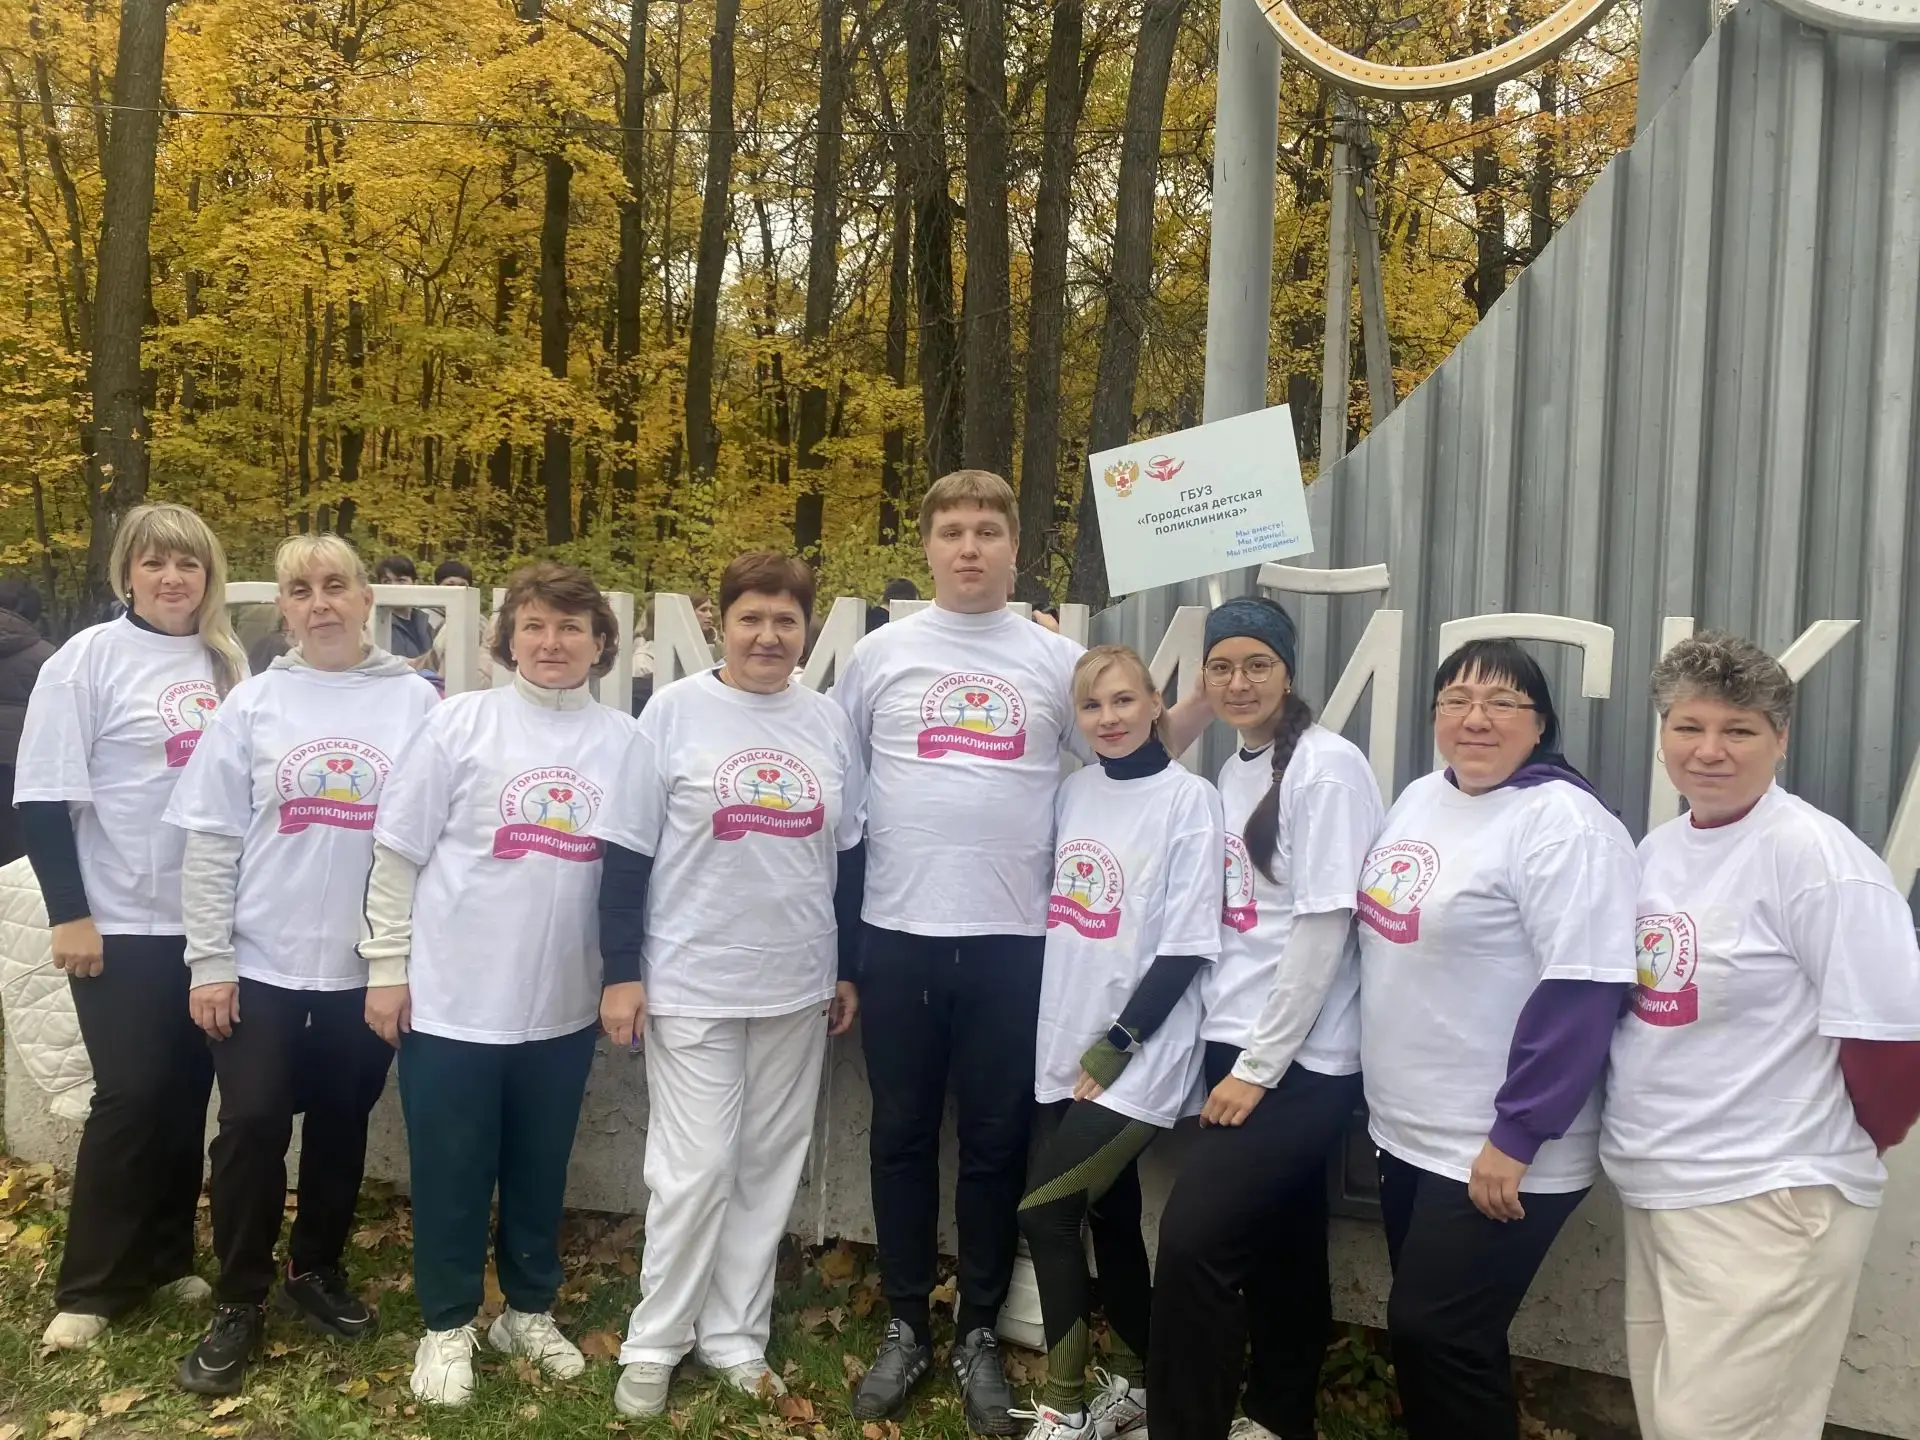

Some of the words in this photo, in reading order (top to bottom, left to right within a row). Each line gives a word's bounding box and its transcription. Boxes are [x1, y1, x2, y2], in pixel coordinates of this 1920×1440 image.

[1180, 485, 1213, 502] ГБУЗ
[1137, 501, 1208, 526] «Городская
[1212, 488, 1263, 510] детская
[1155, 507, 1248, 535] поликлиника»
[1235, 529, 1250, 538] Мы
[1251, 520, 1284, 534] вместе!
[1226, 549, 1241, 557] Мы
[1242, 536, 1299, 554] непобедимы!
[1238, 538, 1252, 546] Мы
[164, 682, 213, 706] ГОРОДСКАЯ
[925, 699, 936, 721] МУЗ
[932, 674, 994, 698] ГОРОДСКАЯ
[994, 683, 1021, 726] ДЕТСКАЯ
[164, 708, 180, 727] МУЗ
[930, 734, 1014, 751] ПОЛИКЛИНИКА
[281, 768, 293, 793] МУЗ
[287, 740, 359, 766] ГОРОДСКАЯ
[723, 751, 783, 775] ГОРОДСКАЯ
[719, 776, 730, 799] МУЗ
[784, 758, 816, 801] ДЕТСКАЯ
[506, 794, 516, 817] МУЗ
[512, 770, 577, 792] ГОРОДСКАЯ
[577, 781, 602, 810] ДЕТС
[289, 806, 376, 821] ПОЛИКЛИНИК
[727, 813, 813, 829] ПОЛИКЛИНИКА
[510, 831, 597, 853] ПОЛИКЛИНИКА
[1057, 842, 1101, 862] ОРОДСКАЯ
[1100, 854, 1118, 903] ДЕТСКАЯ
[1409, 855, 1434, 902] ДЕТСКАЯ
[1360, 901, 1407, 931] ЛИКЛИНИКА
